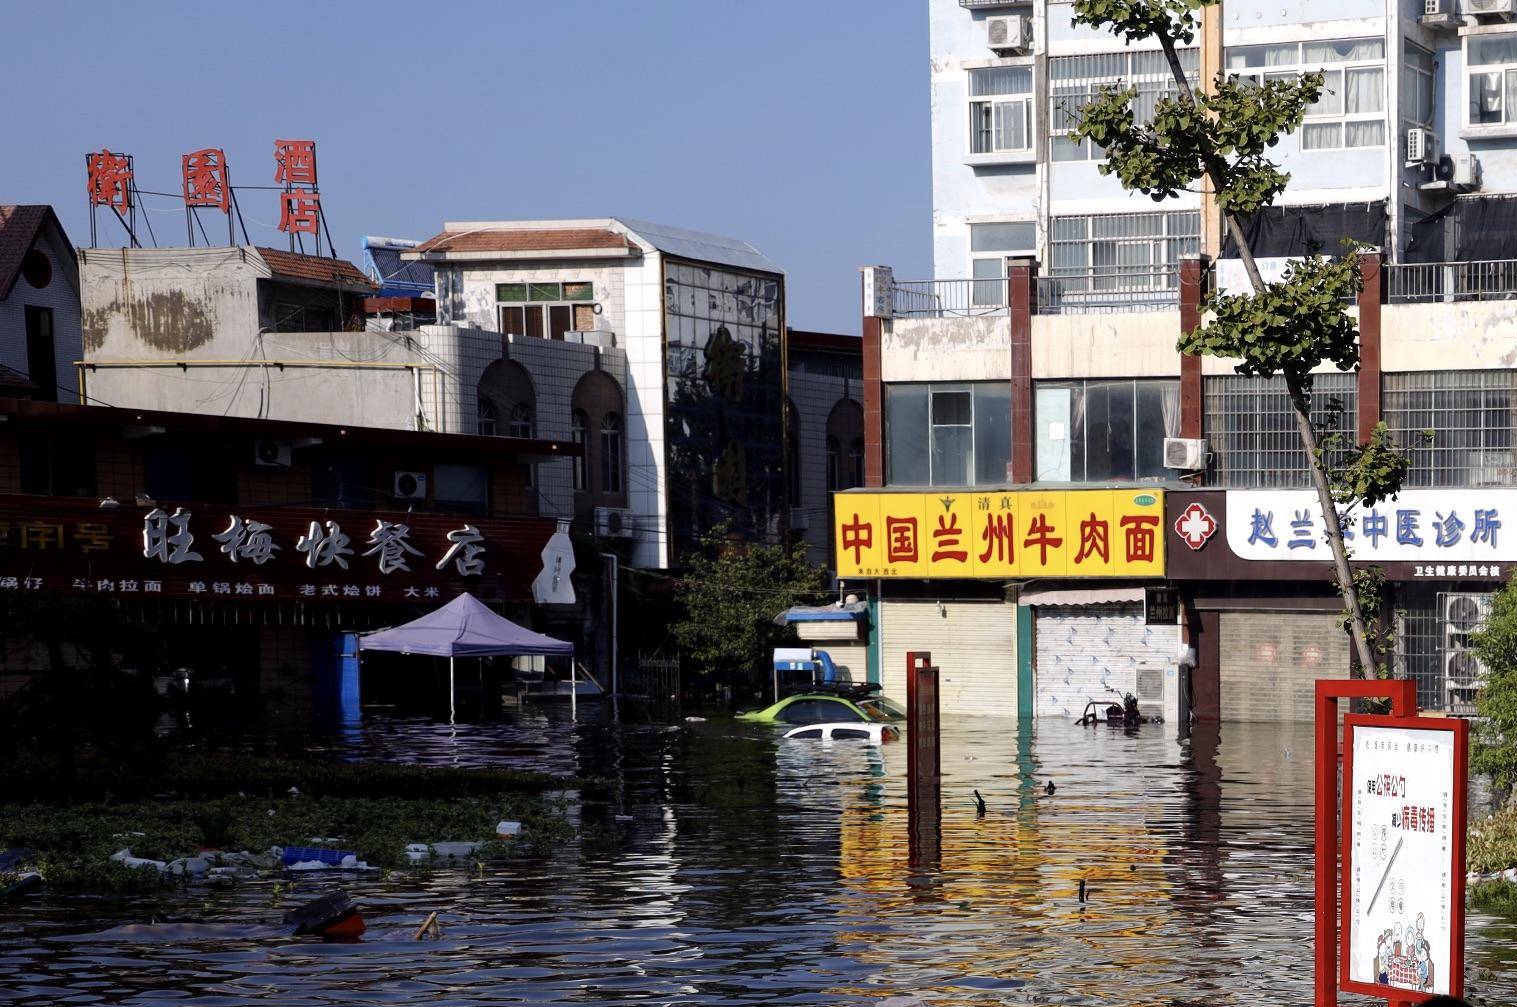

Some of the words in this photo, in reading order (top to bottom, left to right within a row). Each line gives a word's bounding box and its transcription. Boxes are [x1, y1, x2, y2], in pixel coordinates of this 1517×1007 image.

[977, 495, 1013, 511] 清真
[841, 512, 1160, 567] 中国兰州牛肉面
[857, 567, 899, 577] 来自大西北
[188, 580, 275, 595] 单锅烩面
[299, 583, 382, 597] 老式烩饼
[403, 585, 440, 598] 大米
